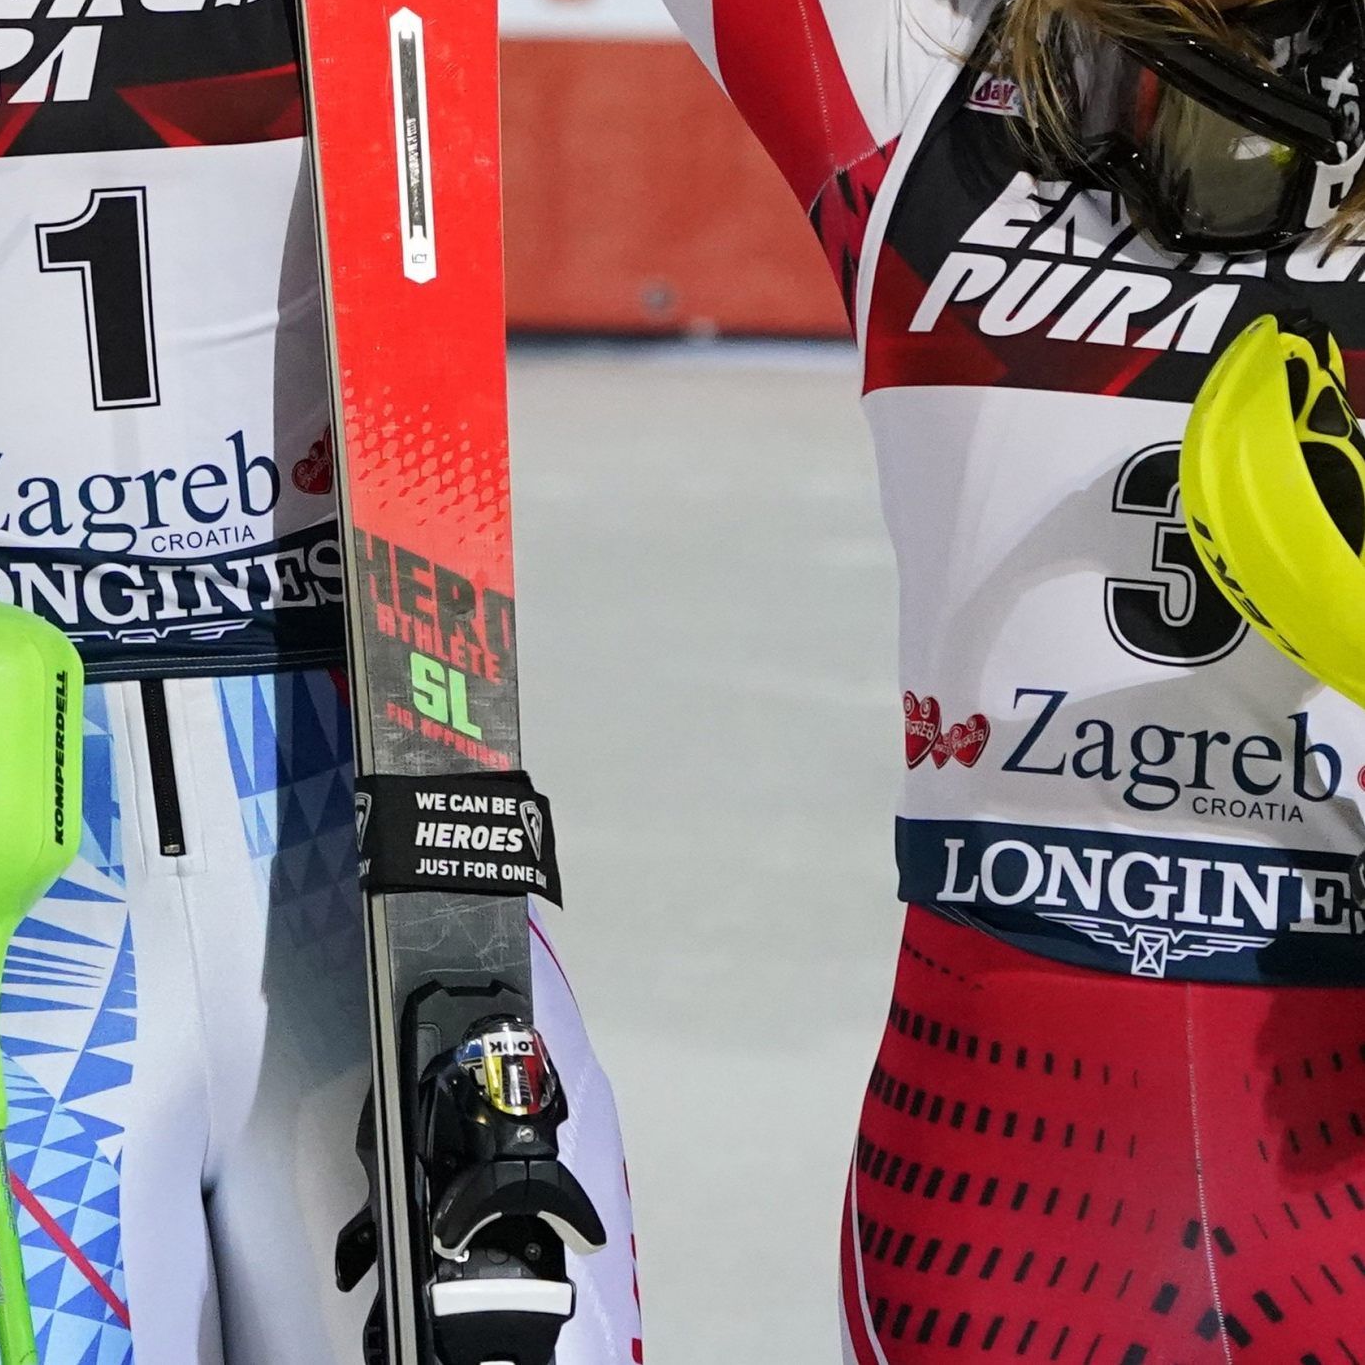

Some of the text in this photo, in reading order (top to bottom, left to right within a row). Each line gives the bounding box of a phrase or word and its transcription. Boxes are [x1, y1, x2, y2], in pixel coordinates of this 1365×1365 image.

[35, 185, 161, 411] 1
[909, 251, 1241, 354] PURA
[151, 525, 256, 554] CROATIA
[1104, 440, 1249, 668] 3
[409, 651, 483, 741] SL
[49, 669, 68, 846] KOMPERDELL
[1001, 687, 1343, 812] Zagreb
[415, 791, 447, 811] WE
[449, 794, 488, 814] CAN
[491, 797, 517, 816] BE
[415, 821, 524, 853] HEROES
[1192, 796, 1305, 824] CROATIA
[415, 858, 459, 875] JUST
[463, 861, 498, 880] FOR
[501, 864, 534, 883] ONE
[935, 838, 1365, 934] LONGINE
